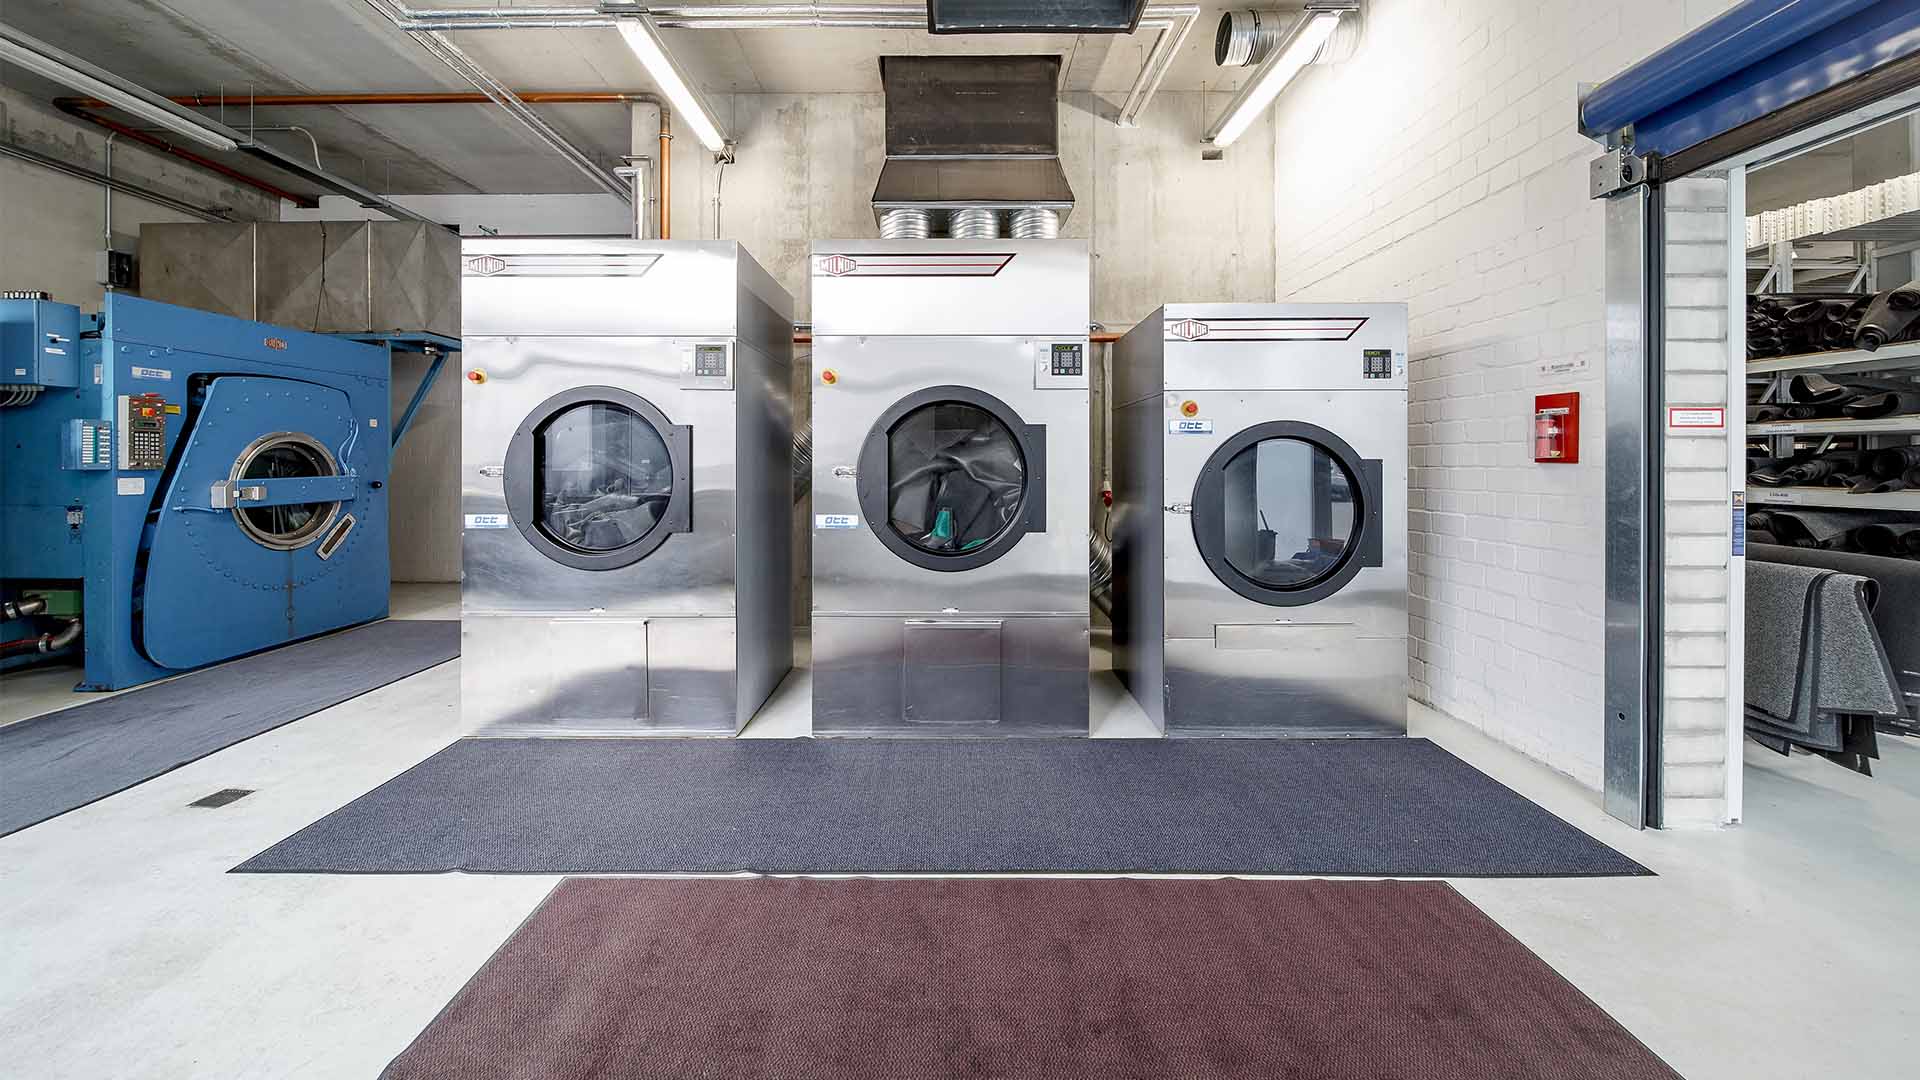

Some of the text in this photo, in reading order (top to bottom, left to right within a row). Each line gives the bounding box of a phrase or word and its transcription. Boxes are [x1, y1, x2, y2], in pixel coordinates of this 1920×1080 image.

[469, 256, 505, 274] MILNOR
[820, 255, 857, 275] MILNOR
[1171, 320, 1208, 340] MILNOR
